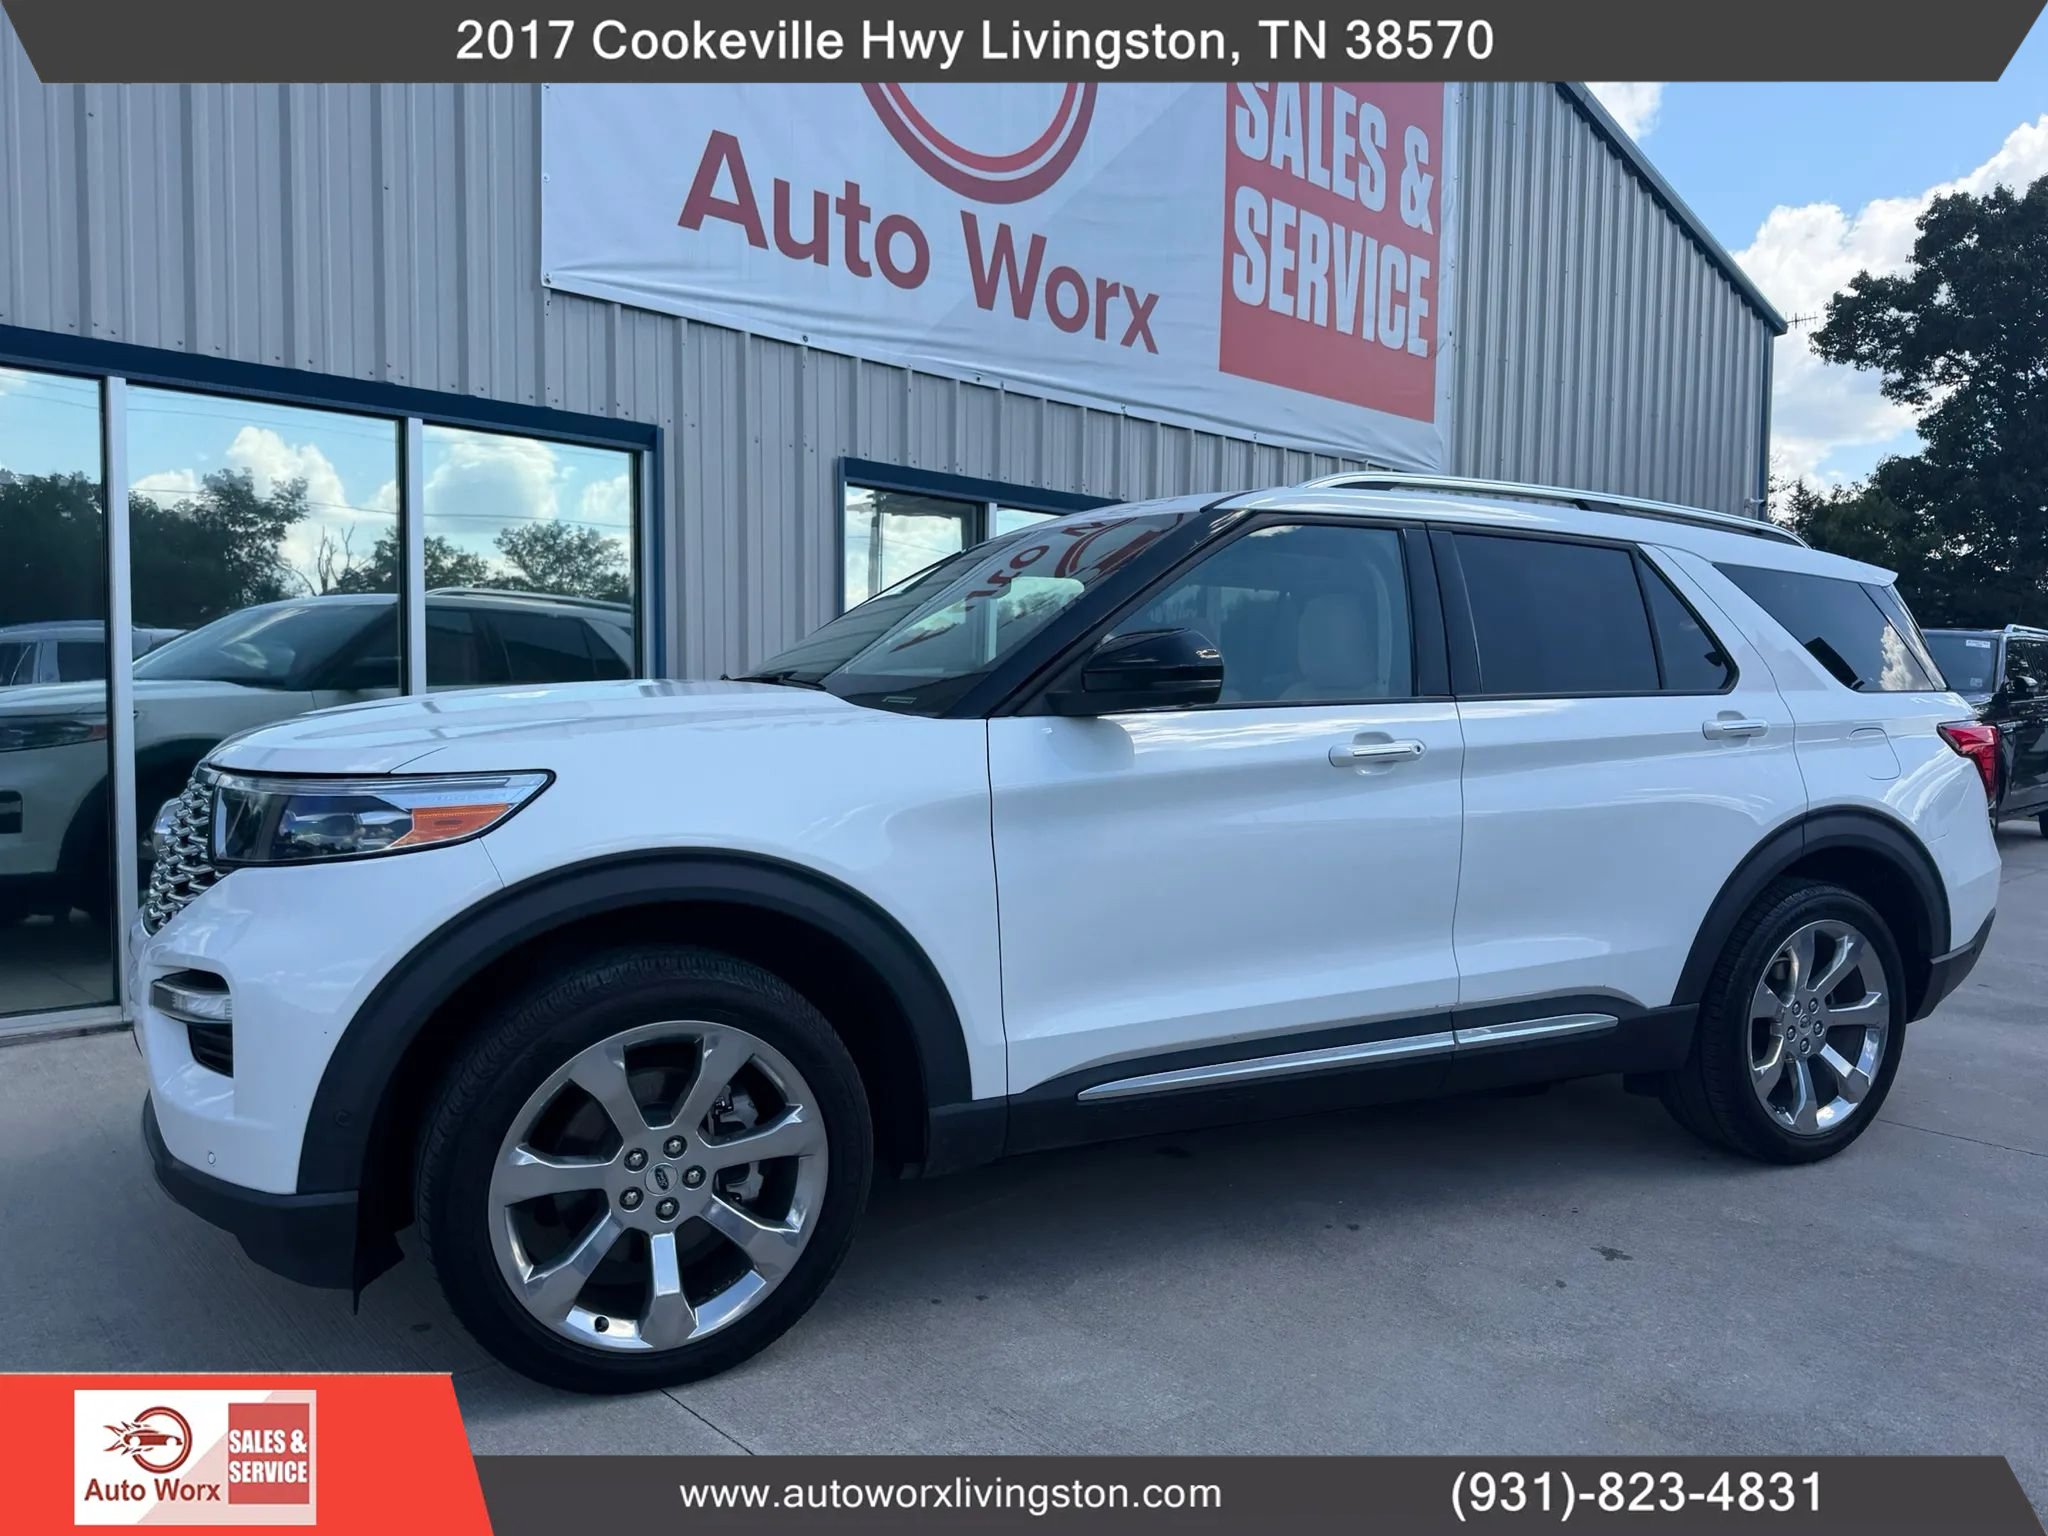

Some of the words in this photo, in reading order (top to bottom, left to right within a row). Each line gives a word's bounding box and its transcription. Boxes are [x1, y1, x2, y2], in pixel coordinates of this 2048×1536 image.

[677, 130, 931, 290] Auto
[960, 210, 1160, 354] Worx
[1234, 82, 1387, 212] SALES
[1400, 125, 1434, 235] &
[1232, 185, 1431, 358] SERVICE
